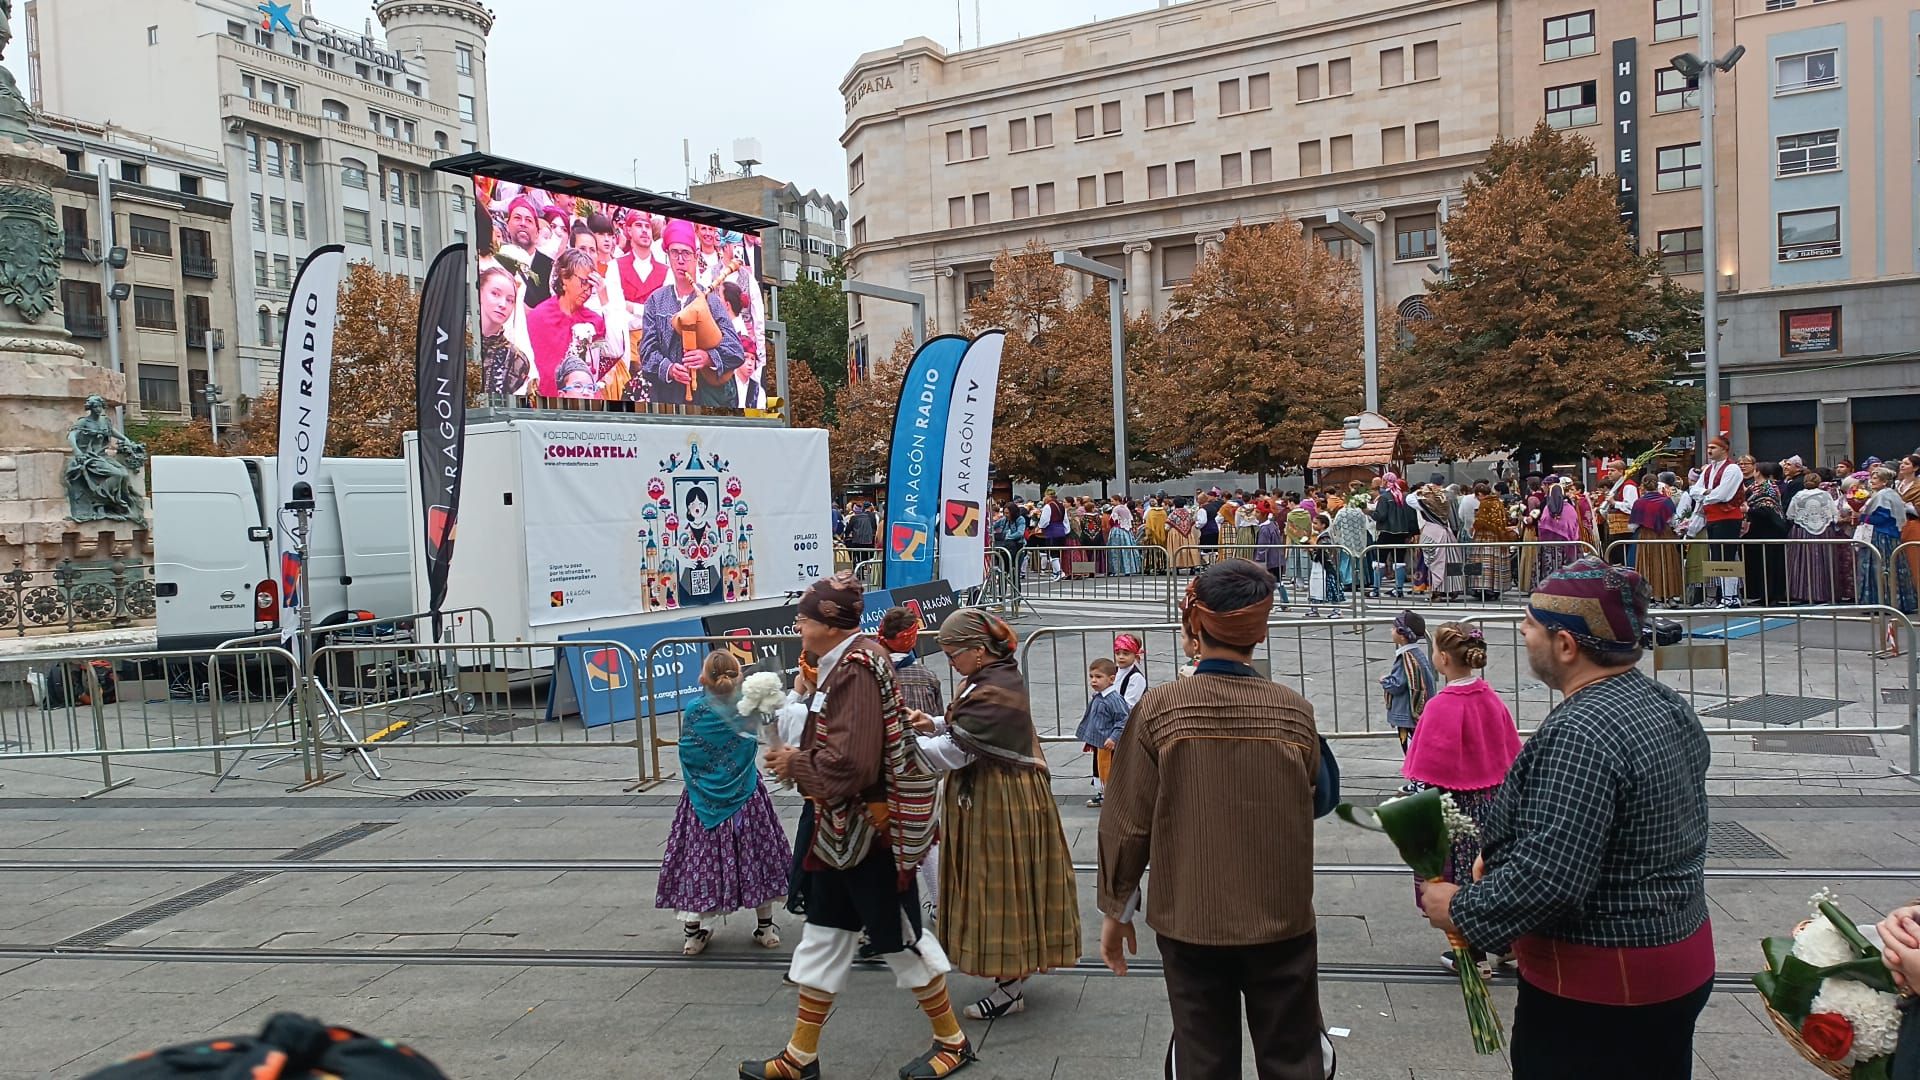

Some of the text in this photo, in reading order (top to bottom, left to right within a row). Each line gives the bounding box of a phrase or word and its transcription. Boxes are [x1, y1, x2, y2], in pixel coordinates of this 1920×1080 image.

[300, 16, 408, 73] CaixaBank
[1618, 61, 1632, 192] HOTEL
[300, 293, 318, 397] RADIO
[436, 326, 449, 364] TV
[544, 443, 638, 460] ¡COMPÁRTELA!
[904, 368, 940, 517] ARAGÓN RADIO
[957, 379, 979, 494] ARAGÓN TV
[565, 589, 591, 597] ARAGÓN
[922, 594, 953, 611] ARAGÓN
[926, 612, 938, 625] TV
[761, 643, 778, 658] TV
